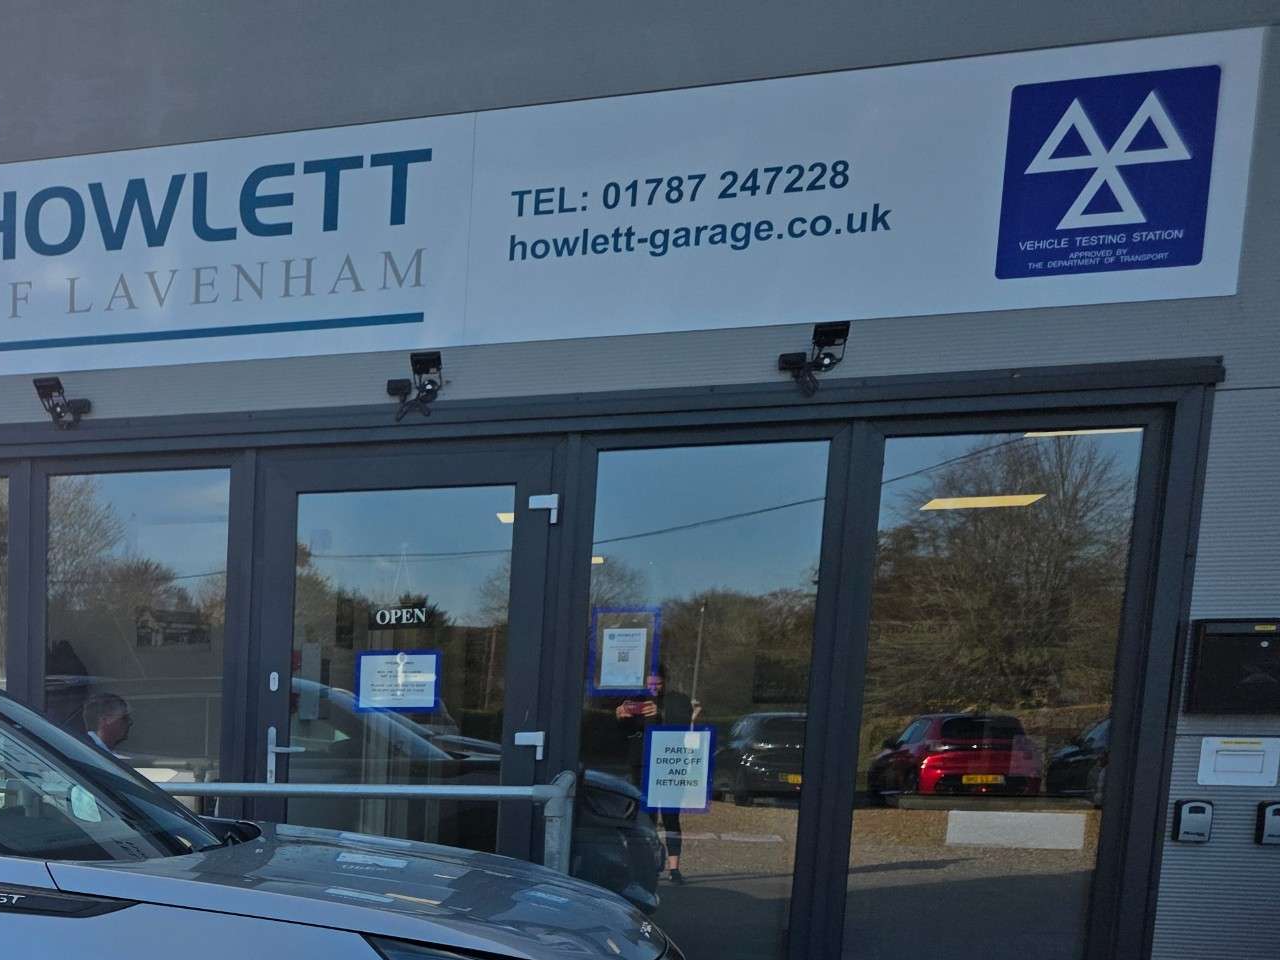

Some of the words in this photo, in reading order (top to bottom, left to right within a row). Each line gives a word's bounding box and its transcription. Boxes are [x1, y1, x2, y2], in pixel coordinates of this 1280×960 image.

[510, 186, 589, 217] TEL:
[602, 173, 707, 210] 01787
[718, 160, 850, 200] 247228
[508, 203, 893, 262] howlett-garage.co.uk
[1019, 237, 1069, 251] VEHICLE
[1075, 233, 1127, 247] TESTING
[1131, 229, 1184, 242] STATION
[1028, 262, 1044, 270] THE
[1047, 258, 1101, 269] DEPARTMENT
[1104, 256, 1116, 264] OF
[1120, 252, 1169, 263] TRANSPORT
[1069, 248, 1113, 259] APPROVED
[1116, 248, 1128, 257] BY
[65, 247, 428, 314] LAVENHAM
[376, 608, 427, 625] OPEN
[656, 757, 682, 765] DROP
[683, 757, 702, 765] OFF
[668, 768, 687, 776] AND
[656, 779, 699, 787] RETURNS
